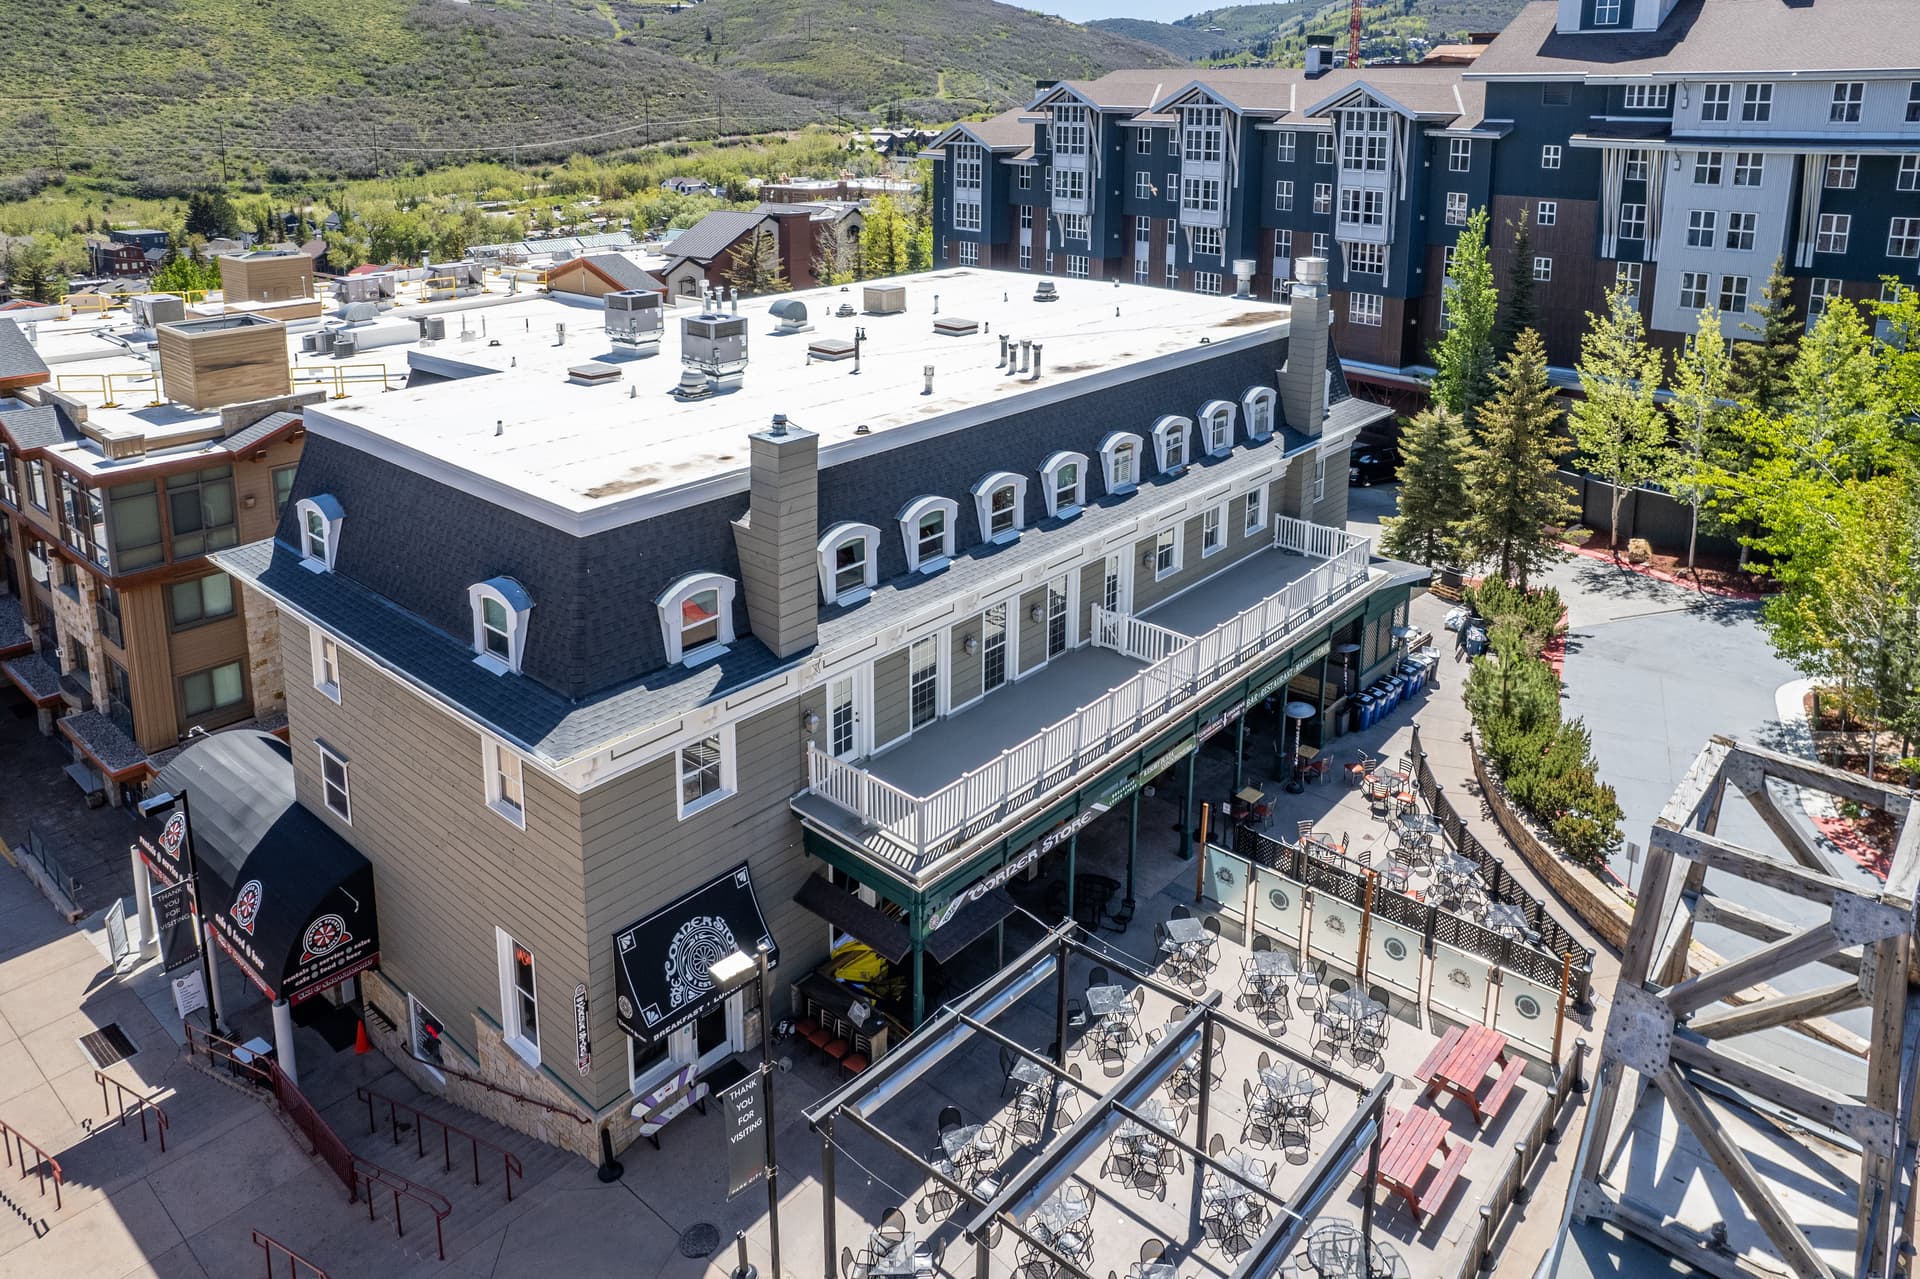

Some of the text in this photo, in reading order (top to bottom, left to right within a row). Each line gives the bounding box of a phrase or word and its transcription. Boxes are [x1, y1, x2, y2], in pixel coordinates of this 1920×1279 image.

[1261, 667, 1294, 698] RESTAURANT
[968, 811, 1092, 902] CORNER STORE
[157, 886, 183, 902] THANK
[164, 898, 180, 909] YOU
[160, 912, 191, 931] VISITING
[165, 908, 181, 919] FOR
[319, 950, 345, 966] service
[664, 915, 713, 982] CORNER
[320, 961, 337, 974] food
[346, 950, 362, 961] beer
[653, 1004, 705, 1042] BREAKFAST
[729, 1078, 758, 1101] THANK
[736, 1095, 755, 1112] YOU
[738, 1109, 755, 1127] FOR
[730, 1116, 763, 1145] VISITING
